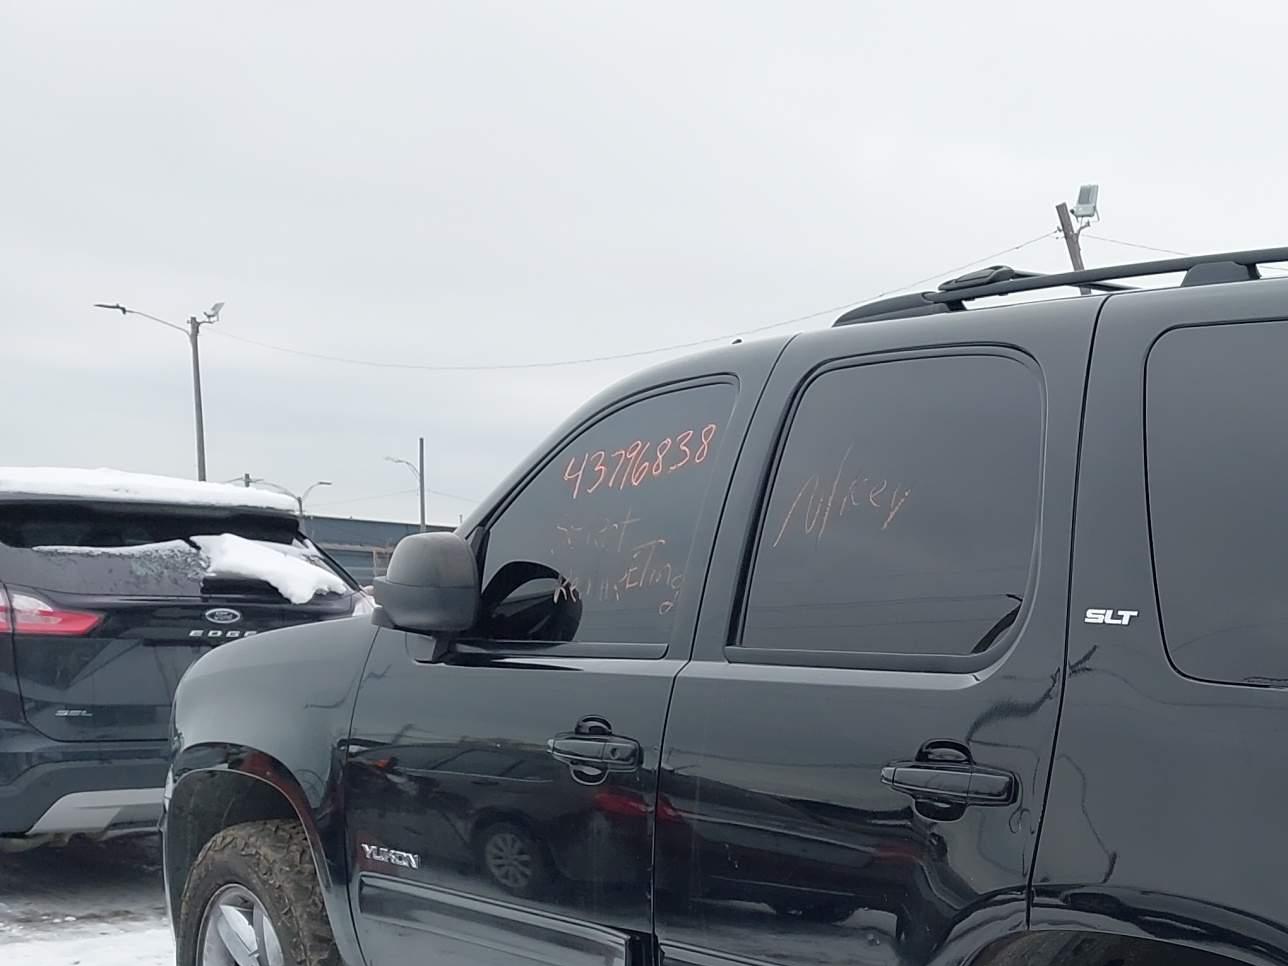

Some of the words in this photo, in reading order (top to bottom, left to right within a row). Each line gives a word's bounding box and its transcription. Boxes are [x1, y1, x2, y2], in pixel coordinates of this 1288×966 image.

[562, 423, 718, 500] 43796838
[1084, 608, 1139, 625] SLT
[361, 843, 420, 870] YUKON
